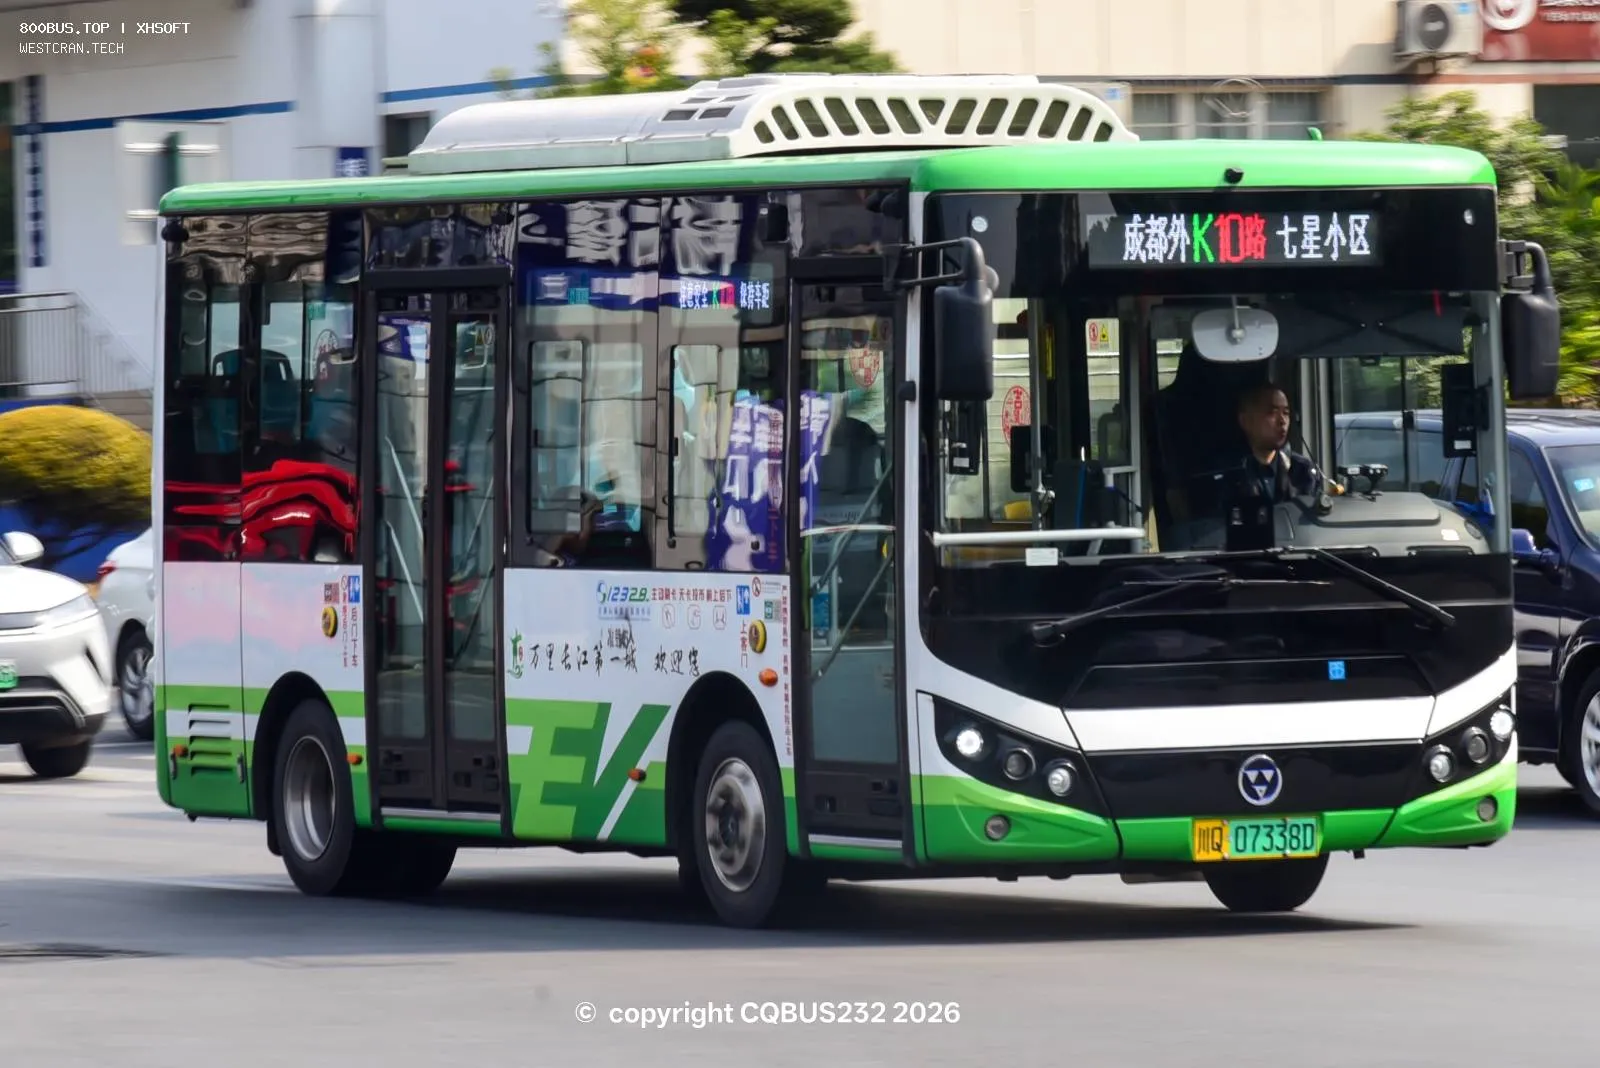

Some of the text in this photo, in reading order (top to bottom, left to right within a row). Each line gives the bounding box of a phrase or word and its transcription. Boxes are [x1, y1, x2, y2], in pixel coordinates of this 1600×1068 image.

[1275, 212, 1371, 261] 七星小区
[1234, 823, 1315, 853] 07338D
